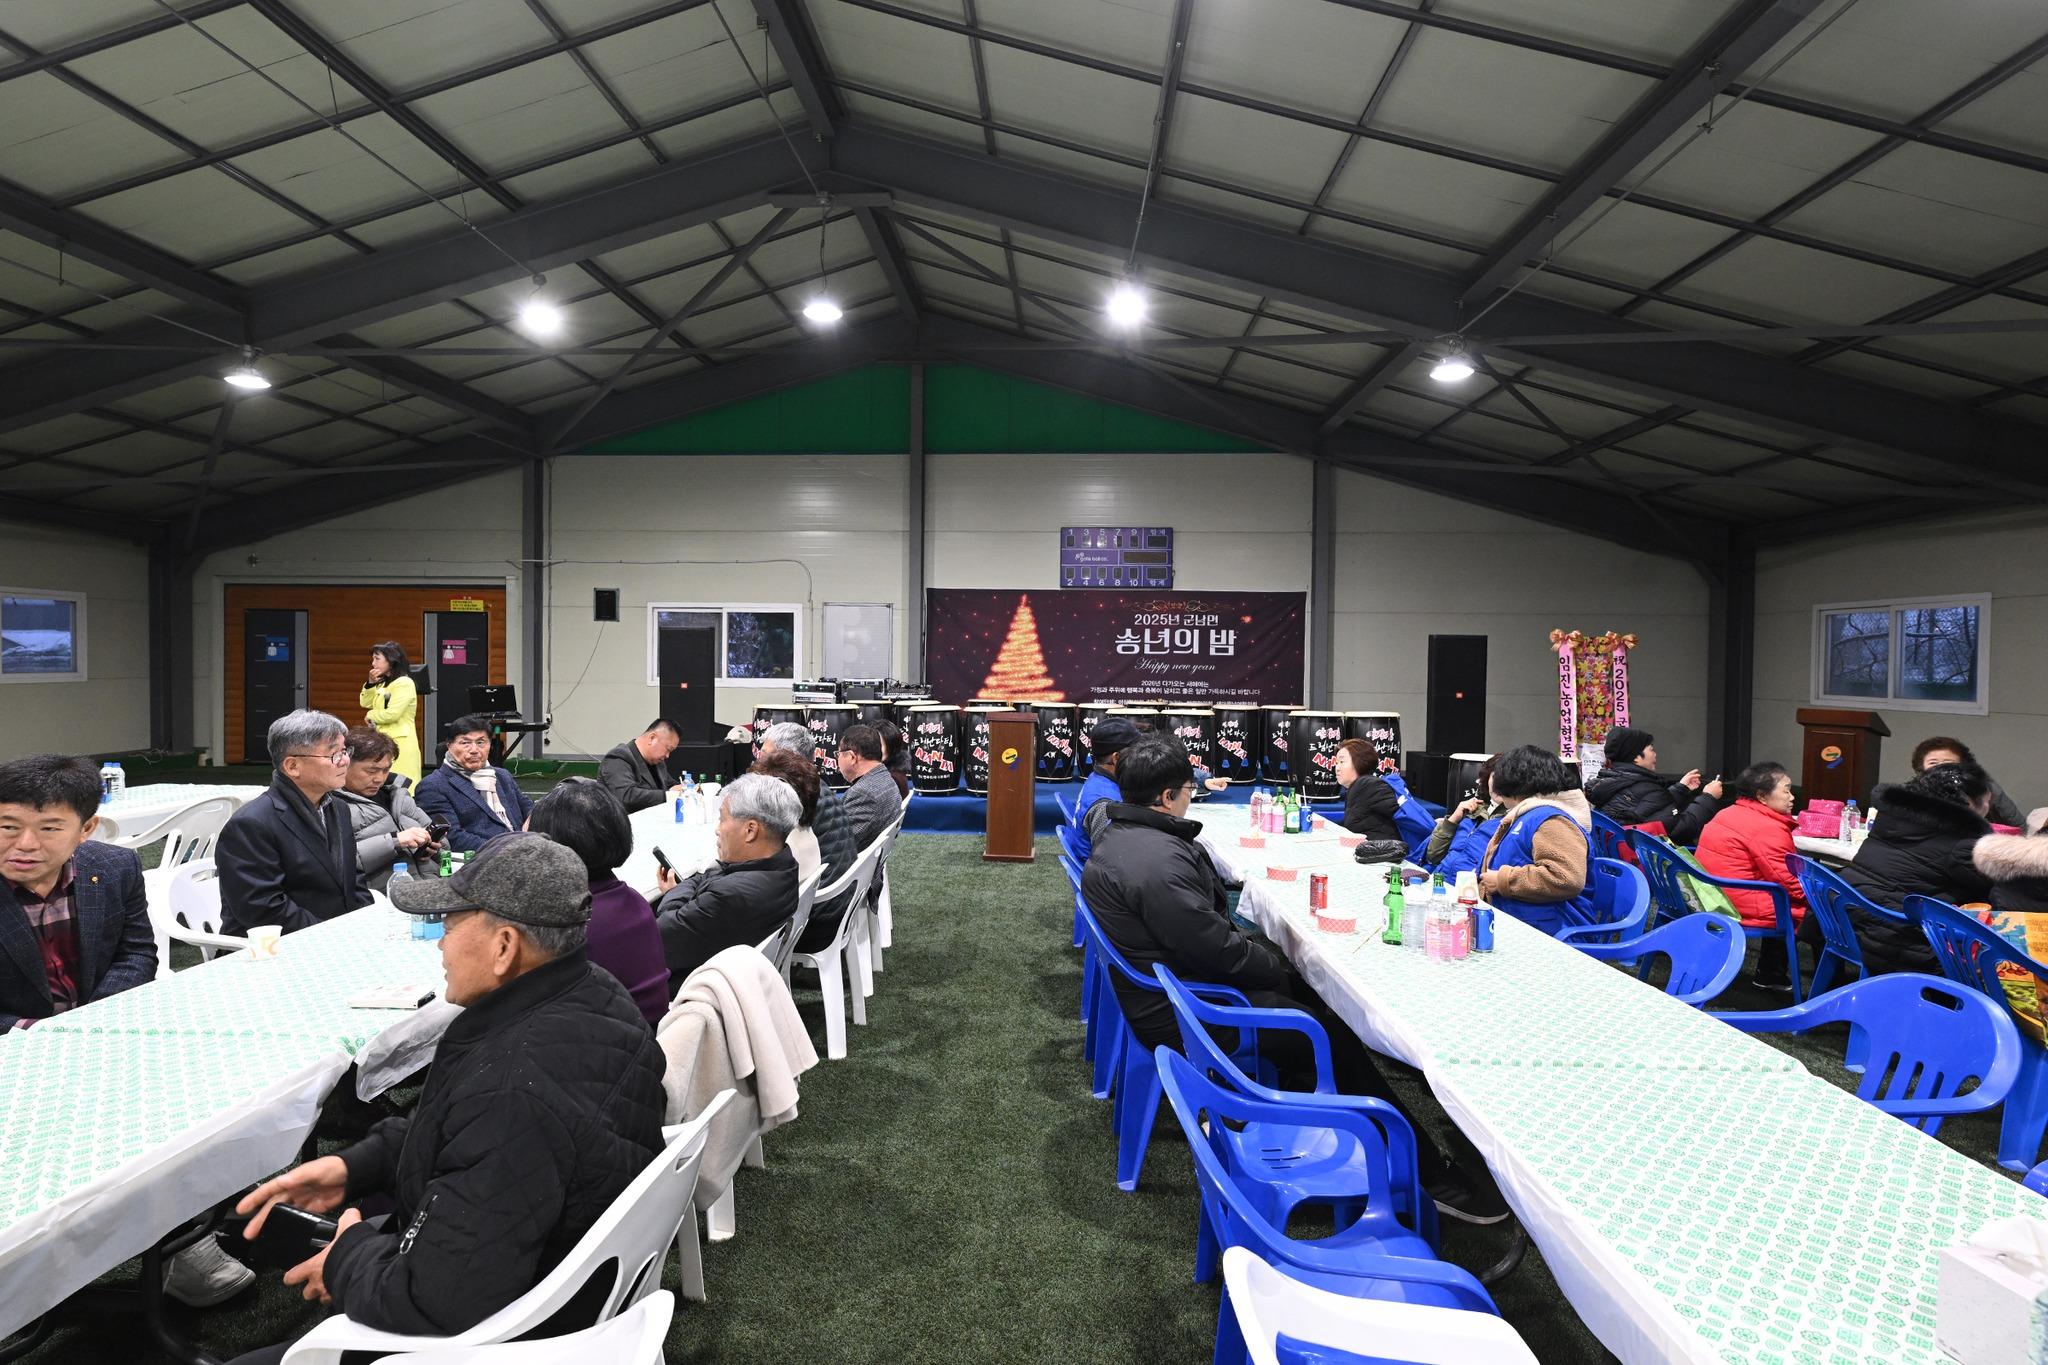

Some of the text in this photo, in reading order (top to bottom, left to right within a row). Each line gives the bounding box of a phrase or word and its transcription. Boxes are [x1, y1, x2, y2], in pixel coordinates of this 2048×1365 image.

[1134, 613, 1219, 626] 2025년 군남면
[1115, 628, 1237, 656] 송년의 밤
[1134, 657, 1170, 674] Happy
[1192, 664, 1216, 674] year
[1162, 680, 1185, 688] 다가오는
[1237, 688, 1260, 696] 바랍니다
